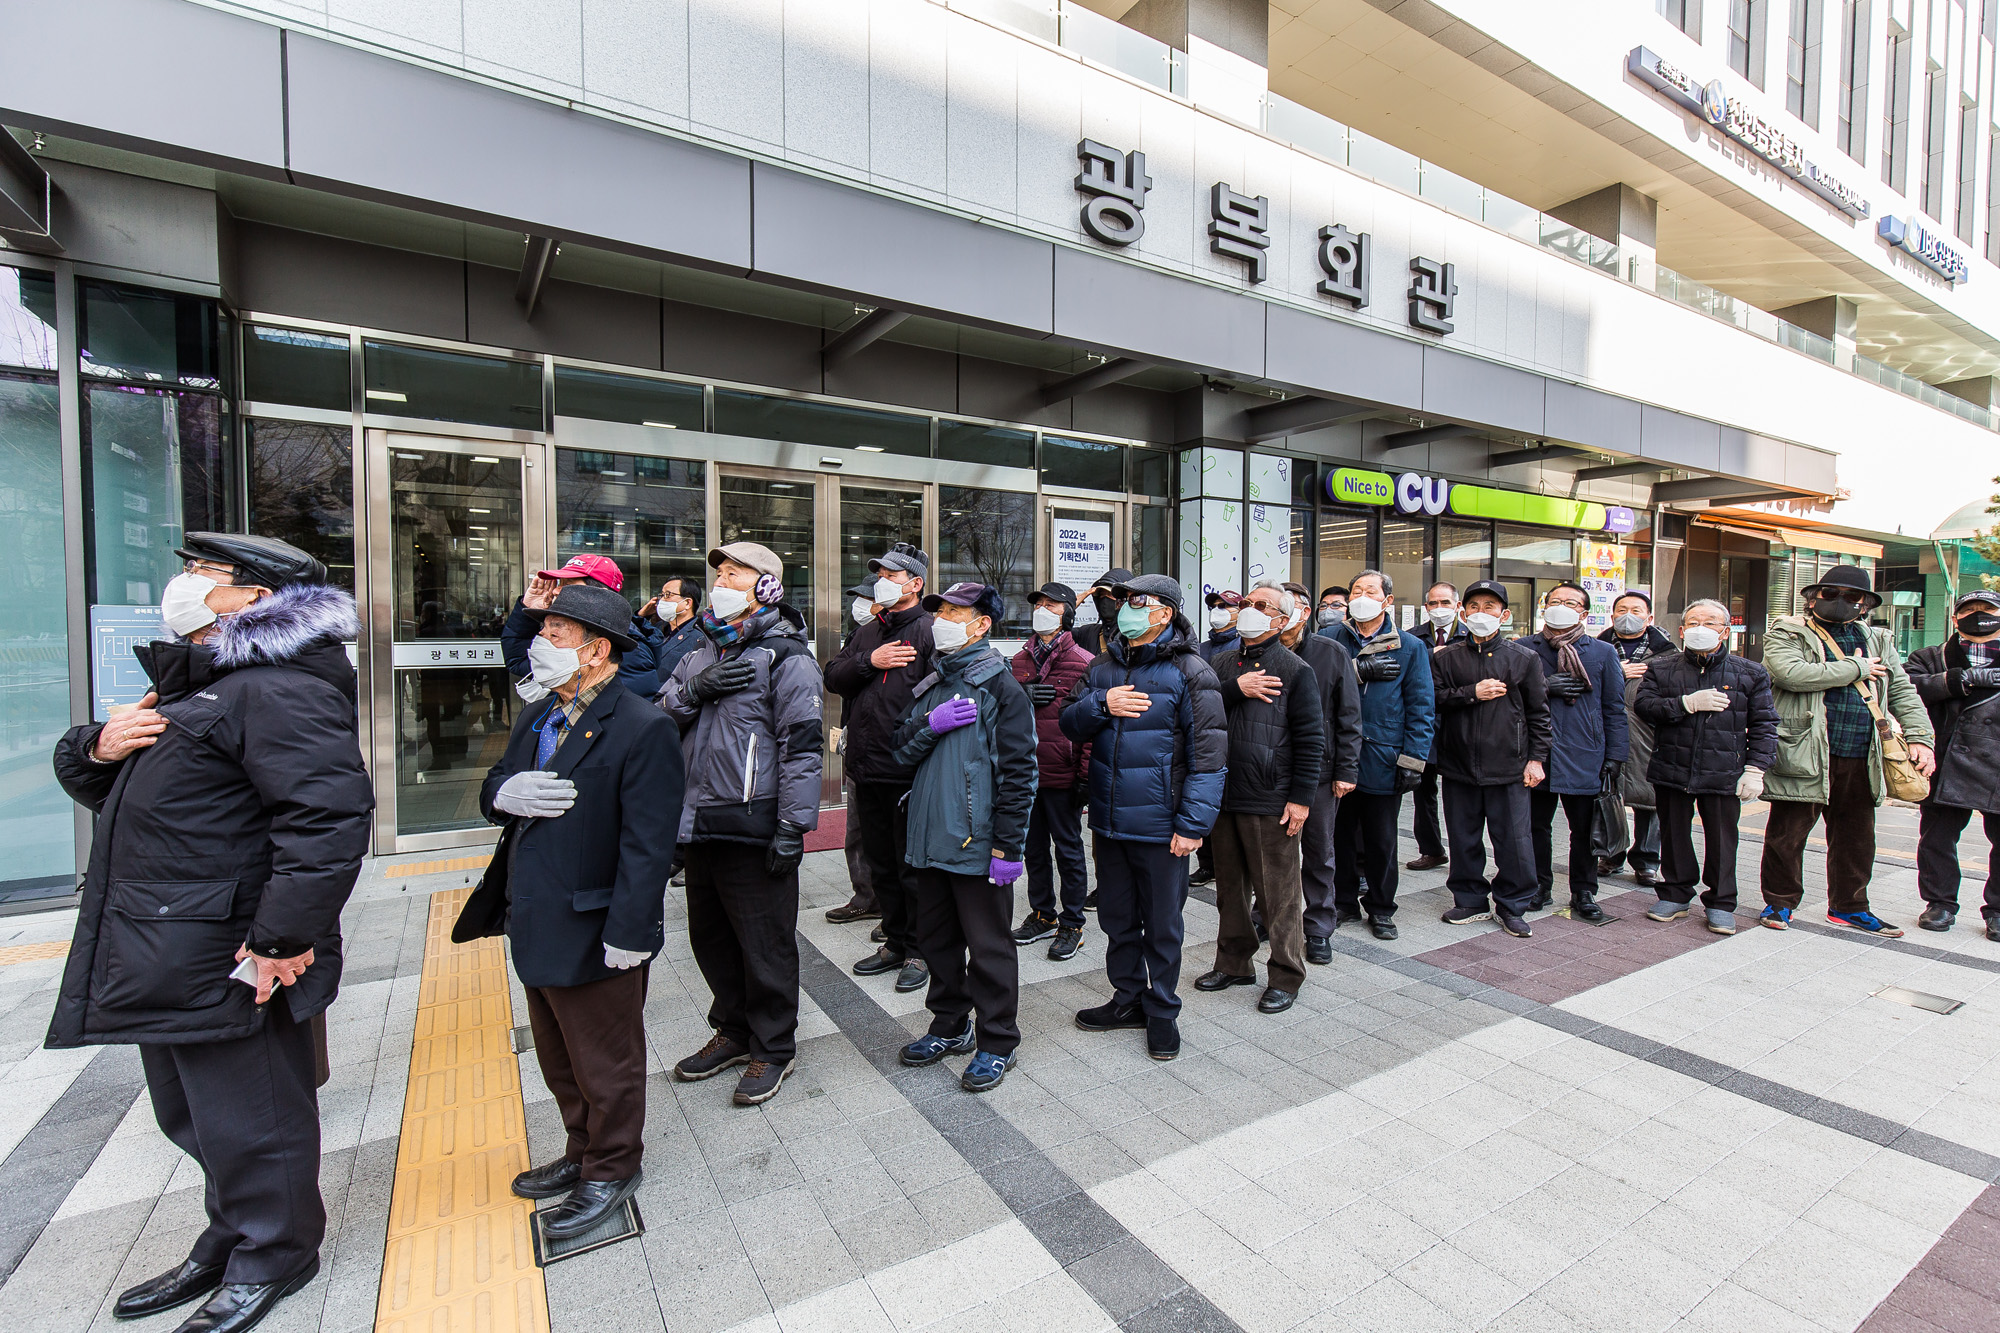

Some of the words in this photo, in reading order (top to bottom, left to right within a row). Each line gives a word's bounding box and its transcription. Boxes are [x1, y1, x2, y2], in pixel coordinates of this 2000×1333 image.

[1075, 138, 1458, 335] 광복회관
[1344, 476, 1372, 495] Nice
[1375, 482, 1387, 496] to
[1398, 472, 1447, 515] CU
[1059, 552, 1088, 562] 기획전시
[1203, 584, 1219, 595] C
[430, 650, 494, 660] 광복회관
